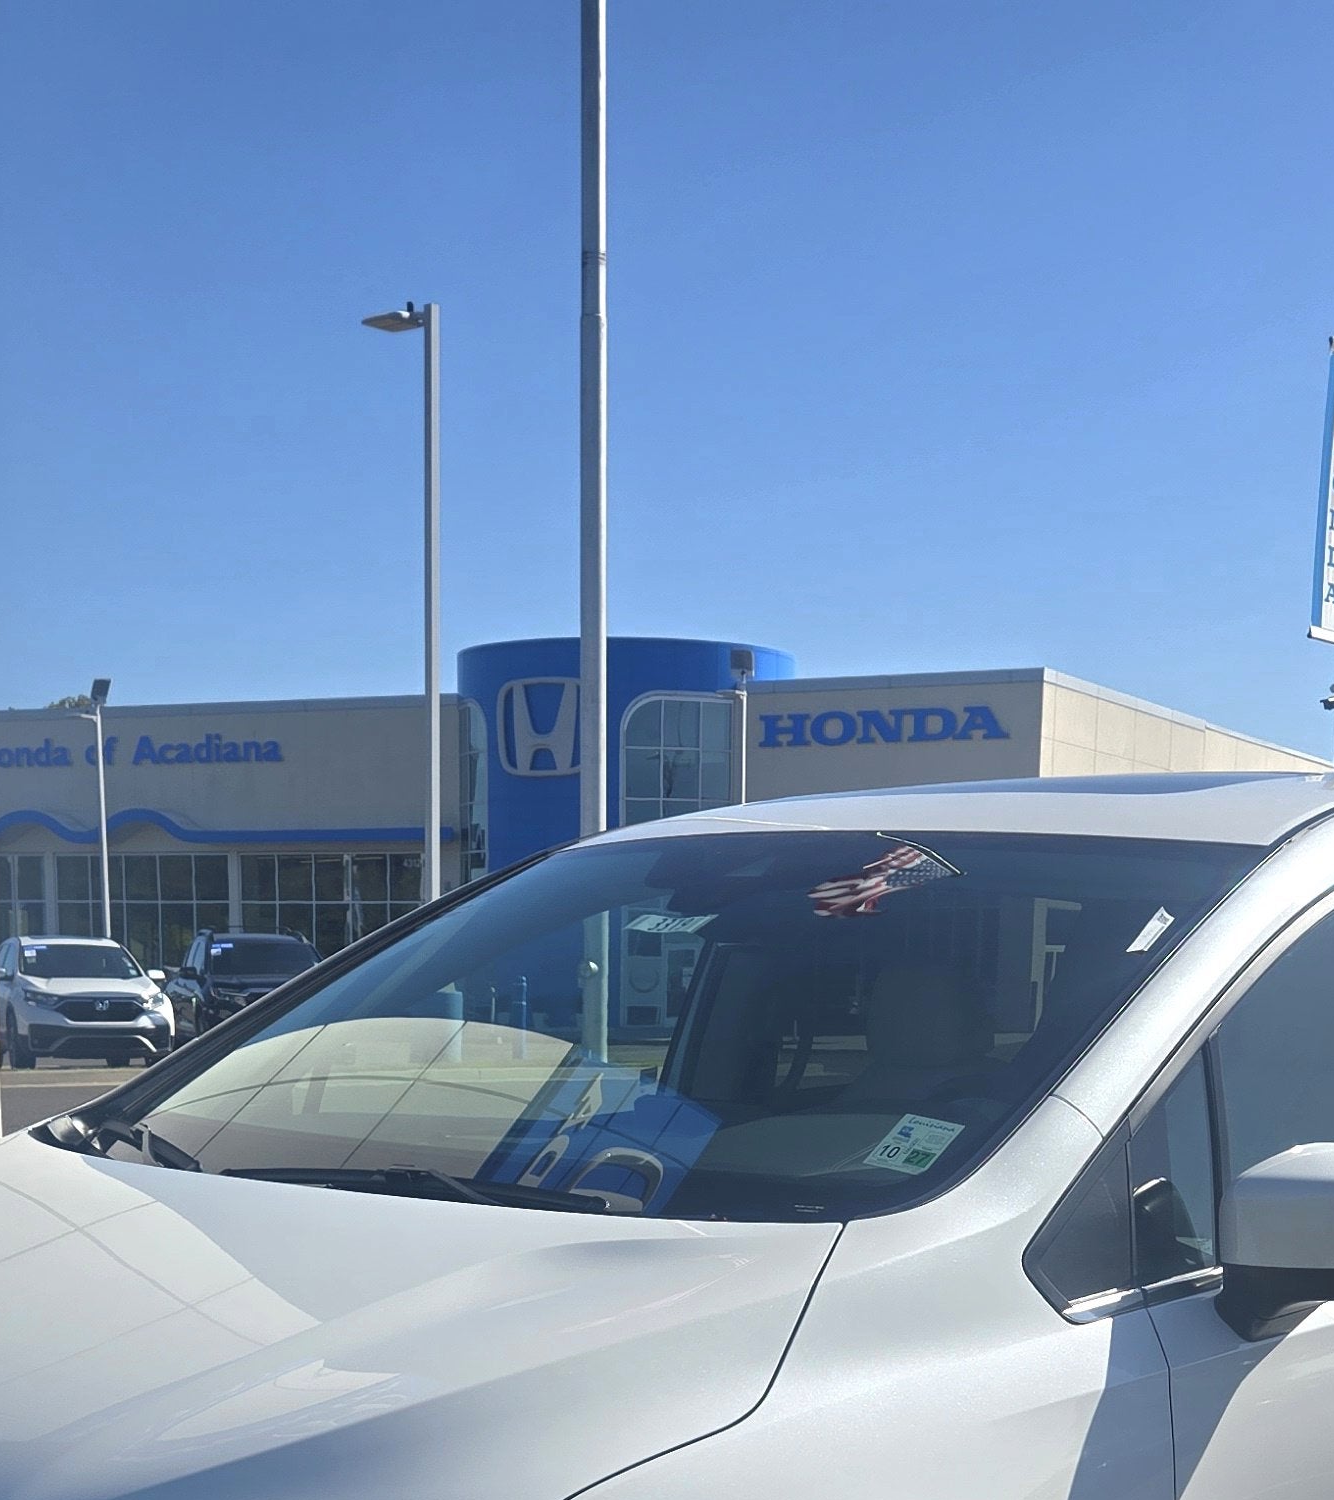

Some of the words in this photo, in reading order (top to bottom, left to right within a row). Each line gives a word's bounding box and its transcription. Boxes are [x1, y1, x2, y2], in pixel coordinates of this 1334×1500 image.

[759, 705, 1011, 748] HONDA
[85, 735, 119, 767] of
[131, 732, 285, 766] Acadiana
[879, 1144, 901, 1159] 10
[907, 1150, 931, 1166] 27
